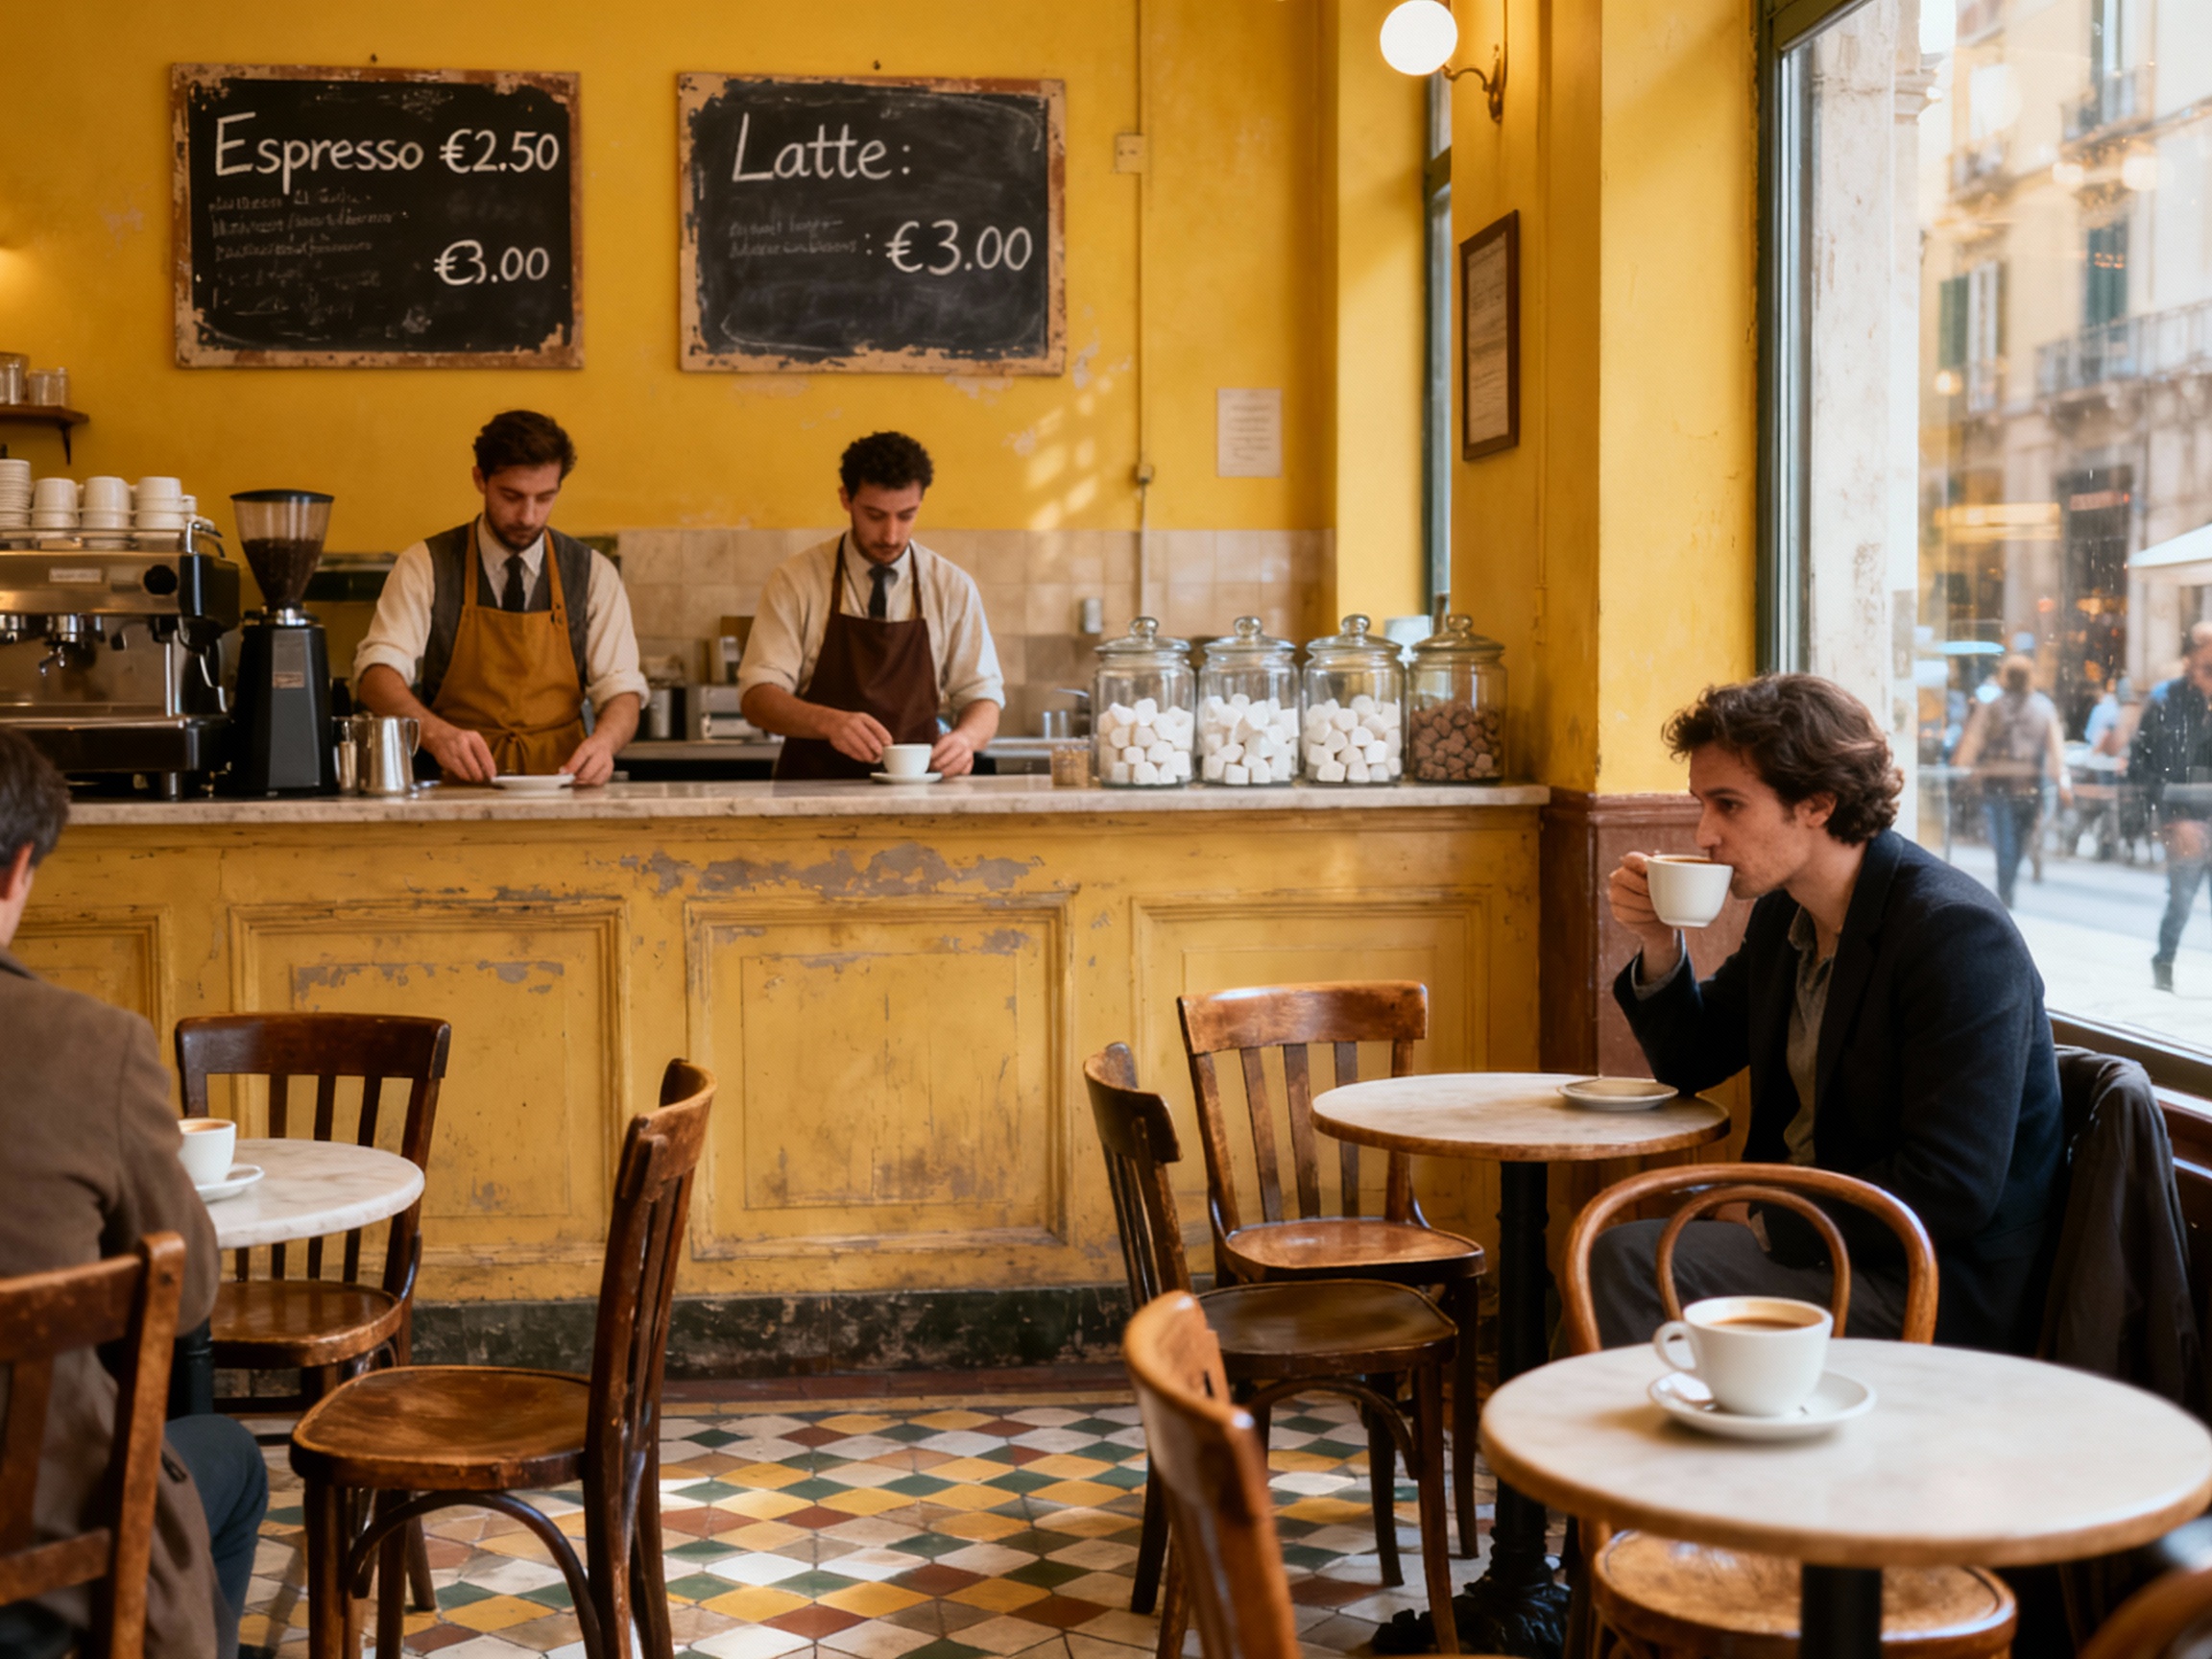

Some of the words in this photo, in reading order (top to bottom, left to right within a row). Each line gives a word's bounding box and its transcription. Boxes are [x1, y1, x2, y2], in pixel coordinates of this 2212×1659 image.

[215, 111, 424, 196] Espresso
[439, 128, 560, 175] €2.50
[732, 111, 911, 182] Latte:
[433, 239, 550, 286] €3.00
[885, 219, 1033, 276] €3.00
